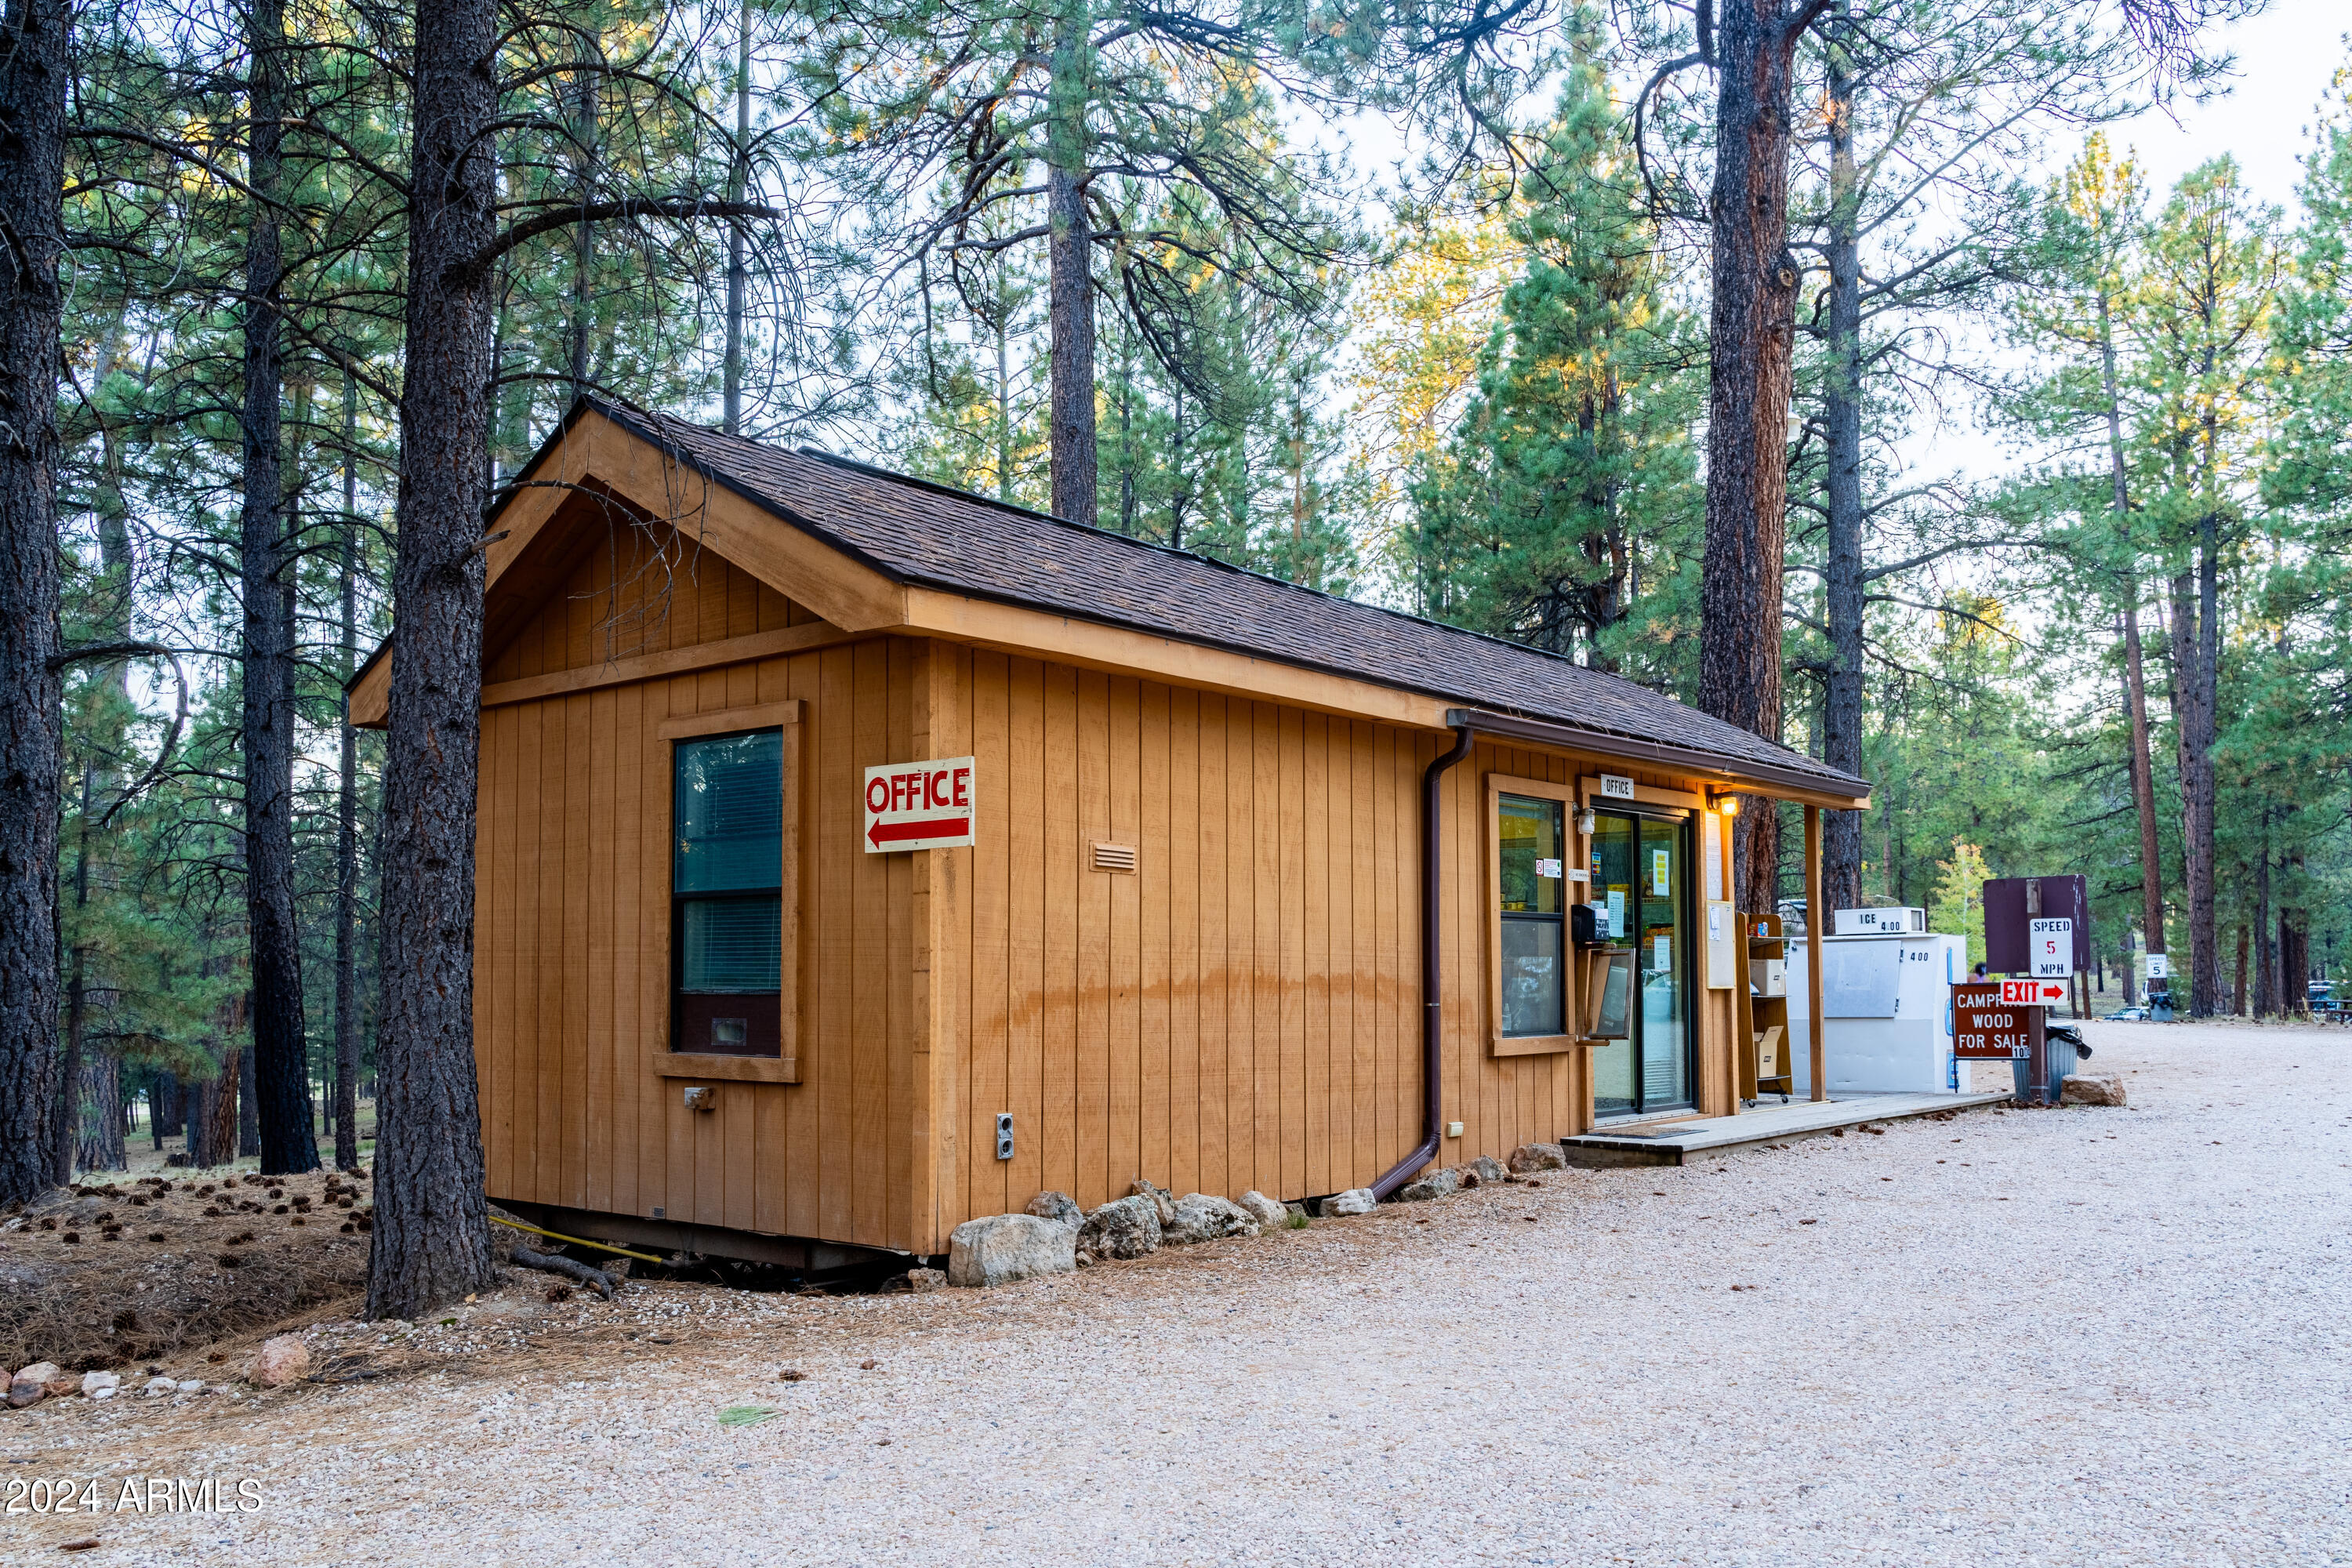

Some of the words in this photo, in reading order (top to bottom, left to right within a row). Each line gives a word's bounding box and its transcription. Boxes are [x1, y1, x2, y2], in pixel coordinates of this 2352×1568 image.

[866, 768, 971, 814] OFFICE
[1606, 779, 1629, 795] OFFICE
[1860, 913, 1876, 924] ICE
[2034, 920, 2071, 932] SPEED
[2046, 940, 2056, 954] 5
[2040, 963, 2064, 975] MPH
[2153, 966, 2161, 975] 5
[2003, 981, 2039, 1003] EXIT
[1956, 993, 2027, 1008] CAMPF
[1972, 1014, 2013, 1029] WOOD
[1958, 1034, 1986, 1049] FOR
[1993, 1034, 2028, 1049] SALE
